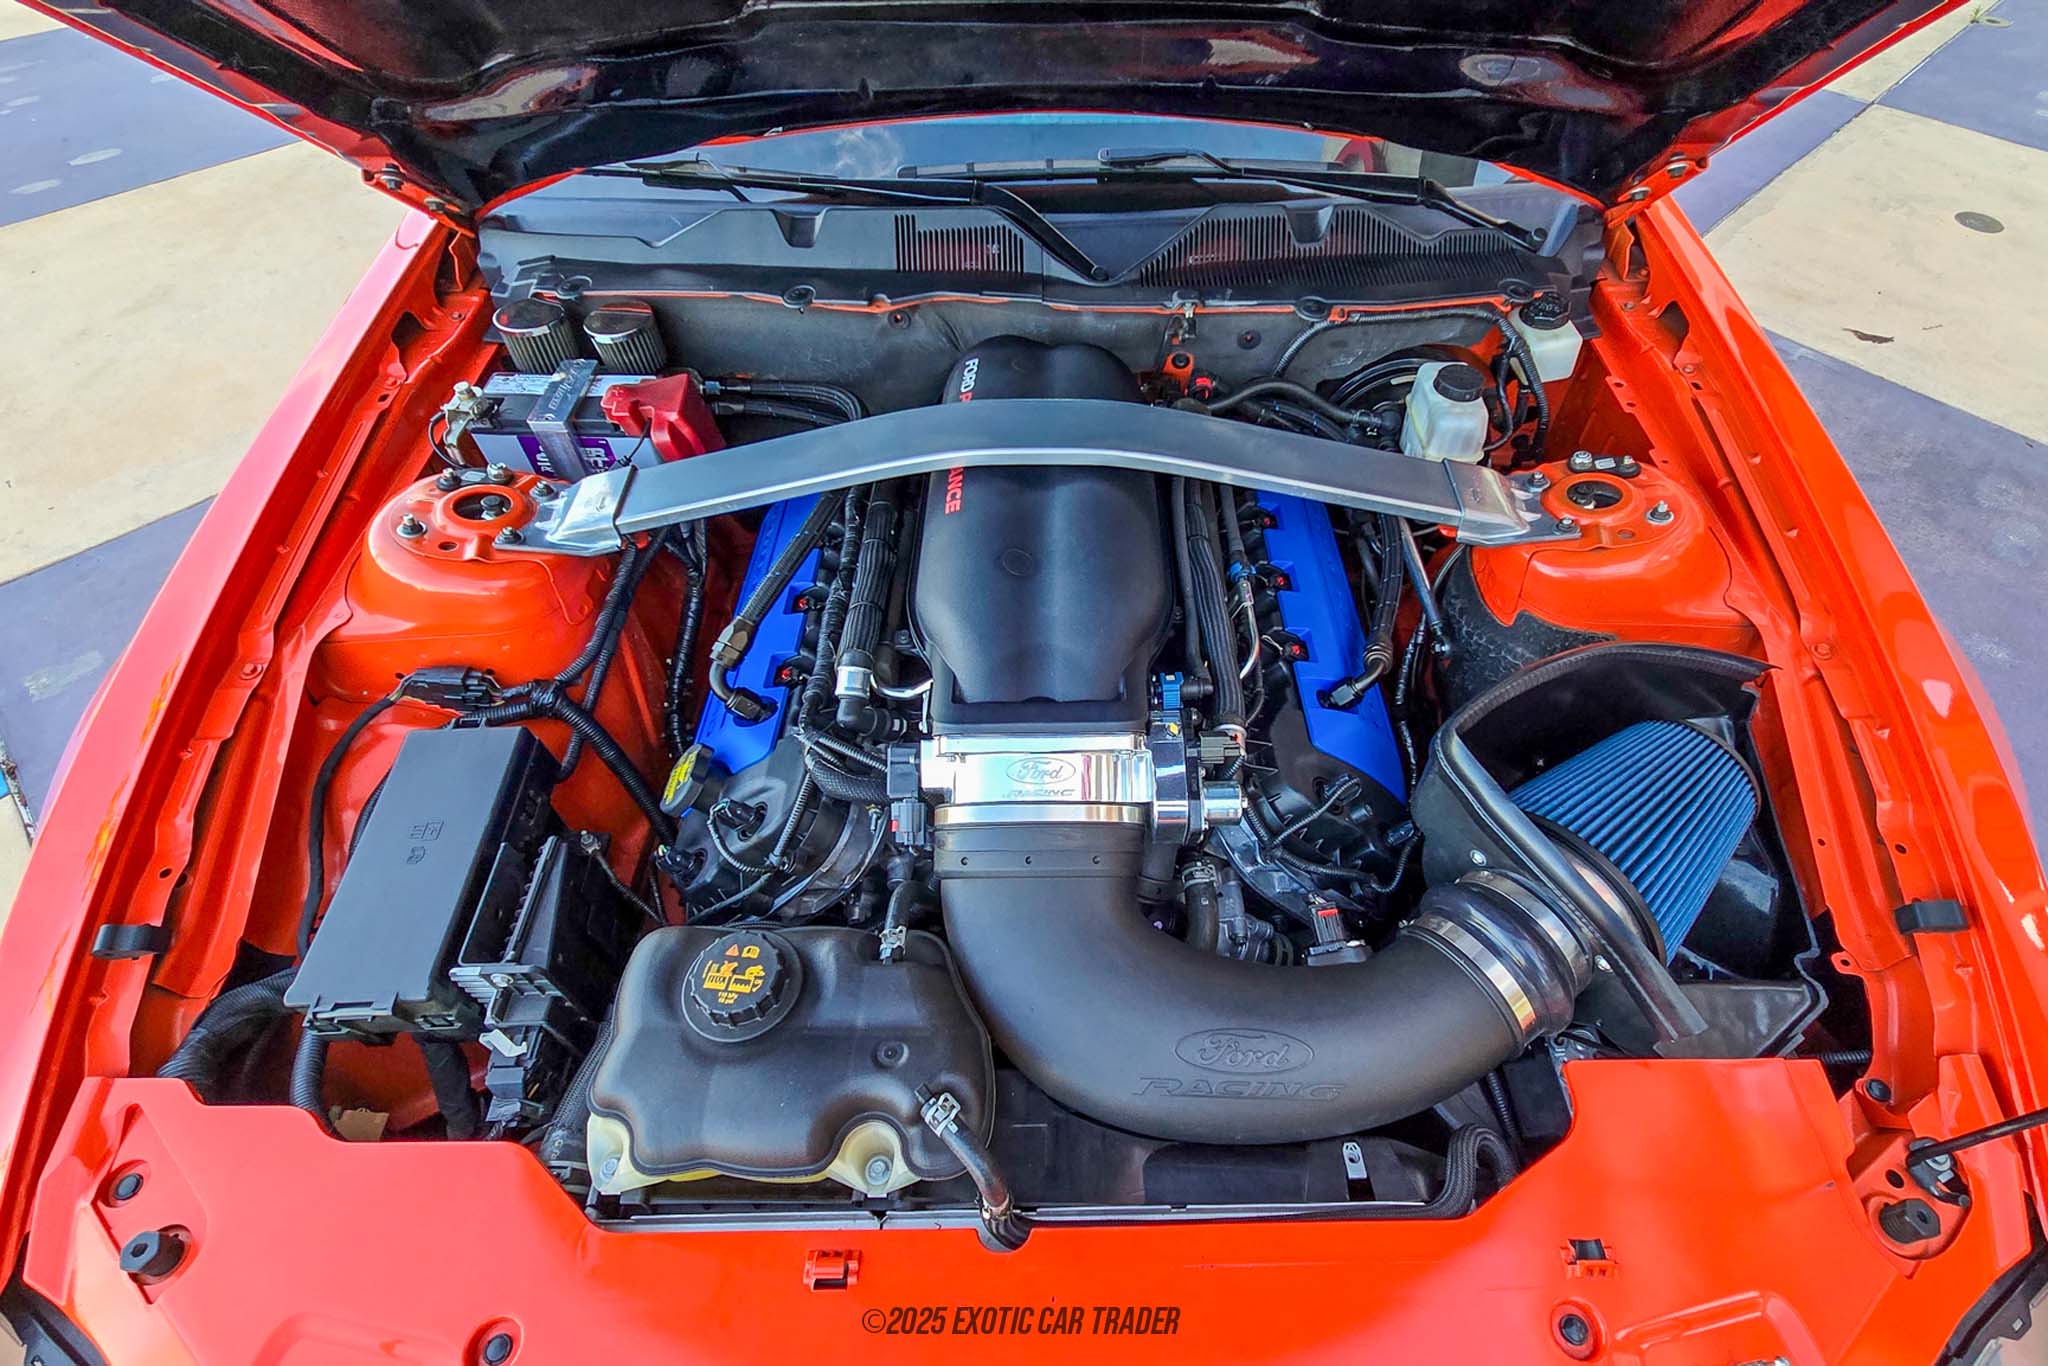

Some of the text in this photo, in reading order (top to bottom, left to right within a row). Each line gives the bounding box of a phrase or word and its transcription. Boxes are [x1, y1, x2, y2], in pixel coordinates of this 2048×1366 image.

[960, 357, 979, 392] FORD
[1016, 760, 1064, 780] Ford
[1198, 1031, 1291, 1068] Ford
[1131, 1076, 1346, 1101] RACING
